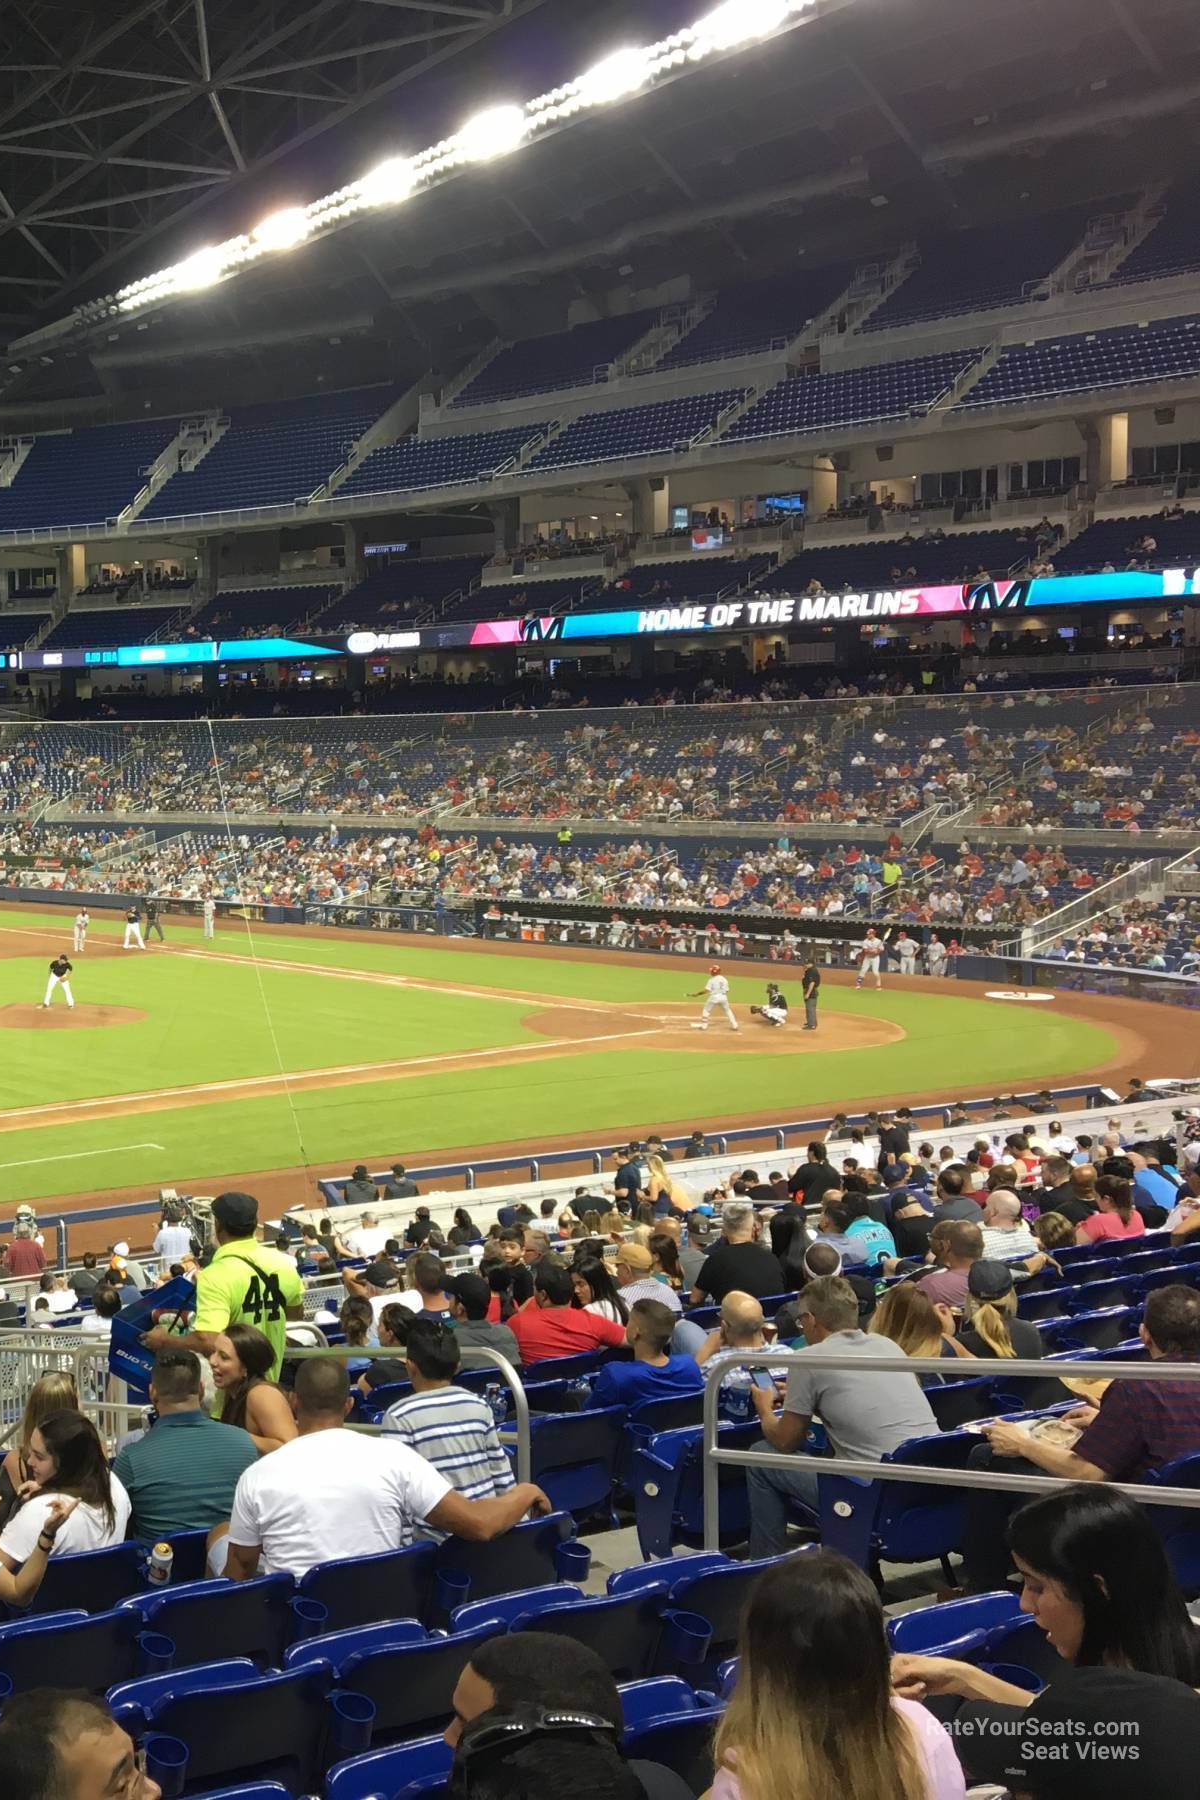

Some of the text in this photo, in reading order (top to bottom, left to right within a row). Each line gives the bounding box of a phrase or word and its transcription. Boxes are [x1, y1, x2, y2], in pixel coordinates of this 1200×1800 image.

[638, 589, 921, 632] HOME OF THE MARLINS
[242, 1272, 286, 1324] 44
[115, 1349, 140, 1364] BUD
